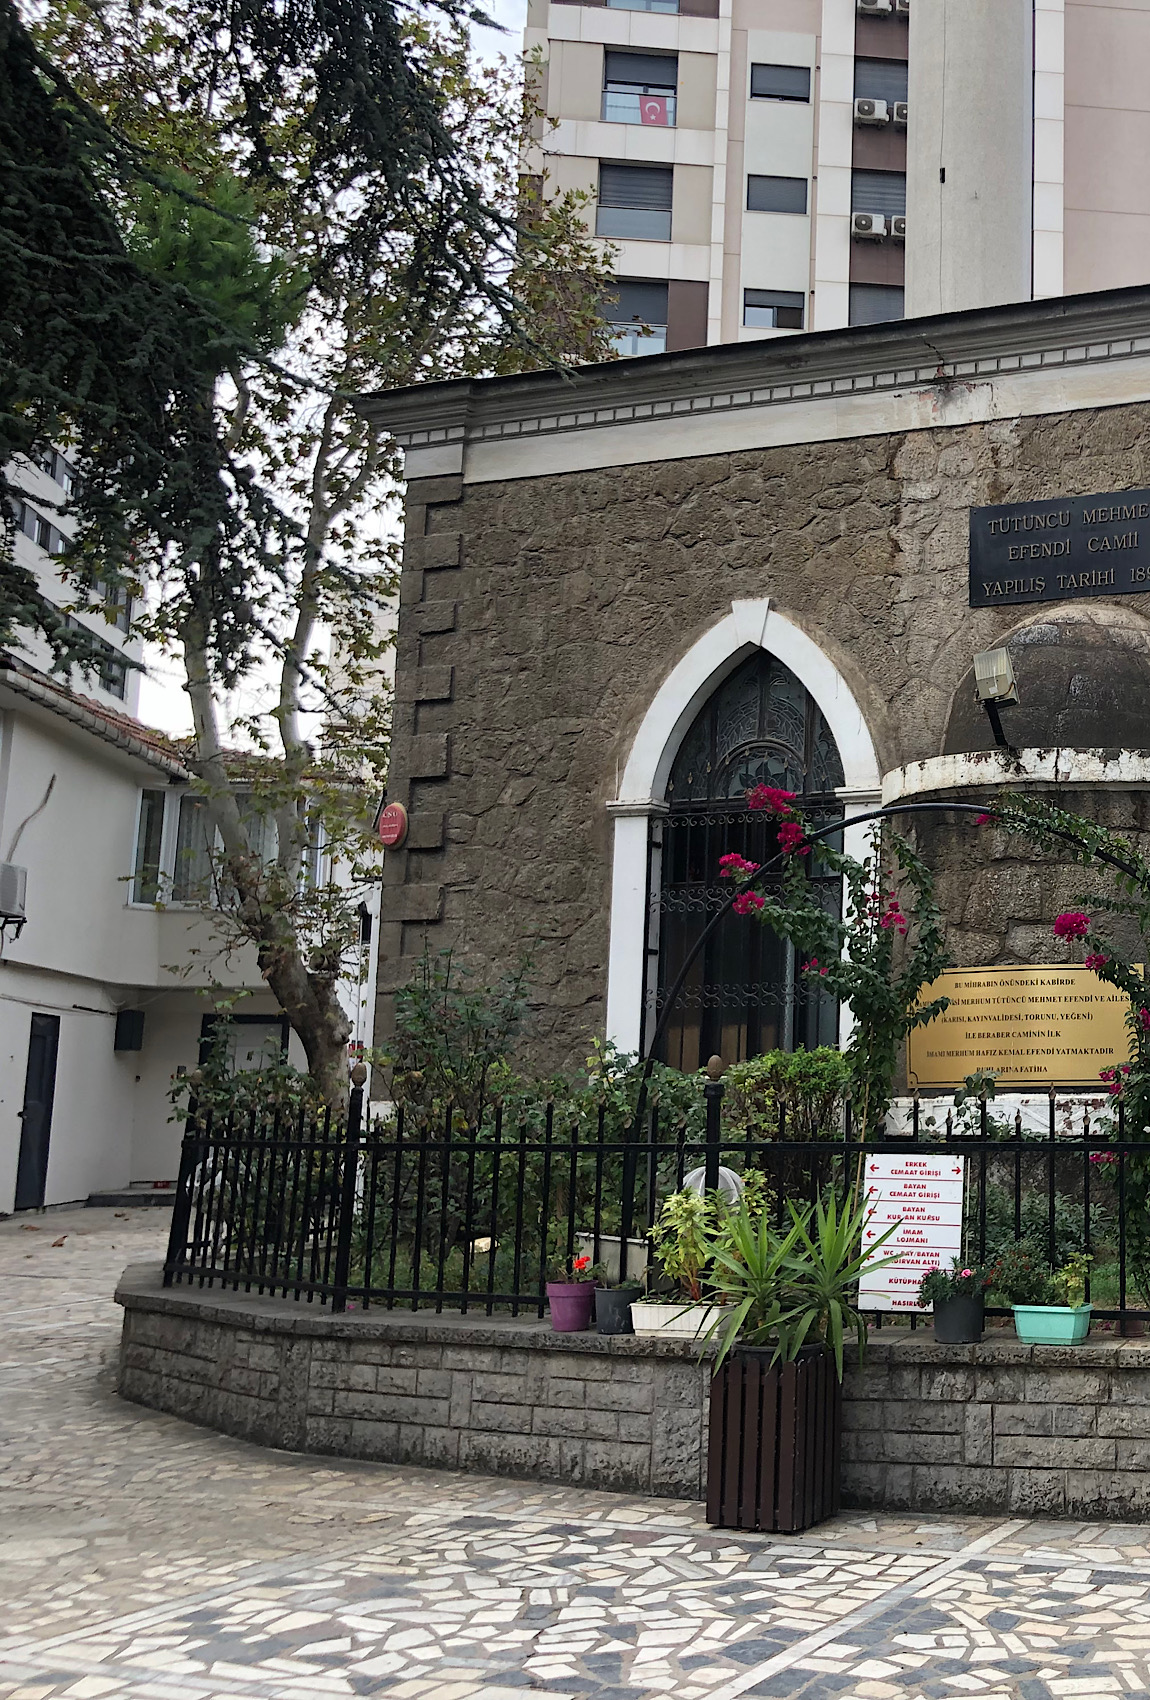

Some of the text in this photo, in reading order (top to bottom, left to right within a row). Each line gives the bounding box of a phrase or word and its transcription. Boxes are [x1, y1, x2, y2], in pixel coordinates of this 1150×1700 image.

[1008, 531, 1139, 560] EFENDİ CAMİİ
[982, 576, 1046, 598] YAPILIŞ
[1057, 568, 1116, 590] TARİHİ
[964, 980, 998, 989] MİHRABIN
[1000, 978, 1039, 987] ÖNÜNDEKİ
[1040, 978, 1076, 986] KABİRDE
[961, 997, 991, 1006] MERHUM
[992, 996, 1027, 1005] TÜTÜNCÜ
[1028, 995, 1062, 1003] MEHMET
[1064, 994, 1093, 1003] EFENDİ
[1106, 994, 1130, 1002] AİLES
[1024, 1013, 1059, 1021] TORUNU,
[1060, 1011, 1094, 1021] YEĞENİ)
[965, 1029, 1062, 1039] İLE BERABER CAMİNİN İLK
[946, 1049, 975, 1057] MERHUM
[976, 1048, 997, 1056] HAFIZ
[998, 1047, 1025, 1056] KEMAL
[1026, 1047, 1055, 1055] EFENDİ
[1056, 1047, 1114, 1055] YATMAKTADIR
[1020, 1064, 1048, 1072] FATİHA
[919, 1169, 941, 1177] GİRİŞİ
